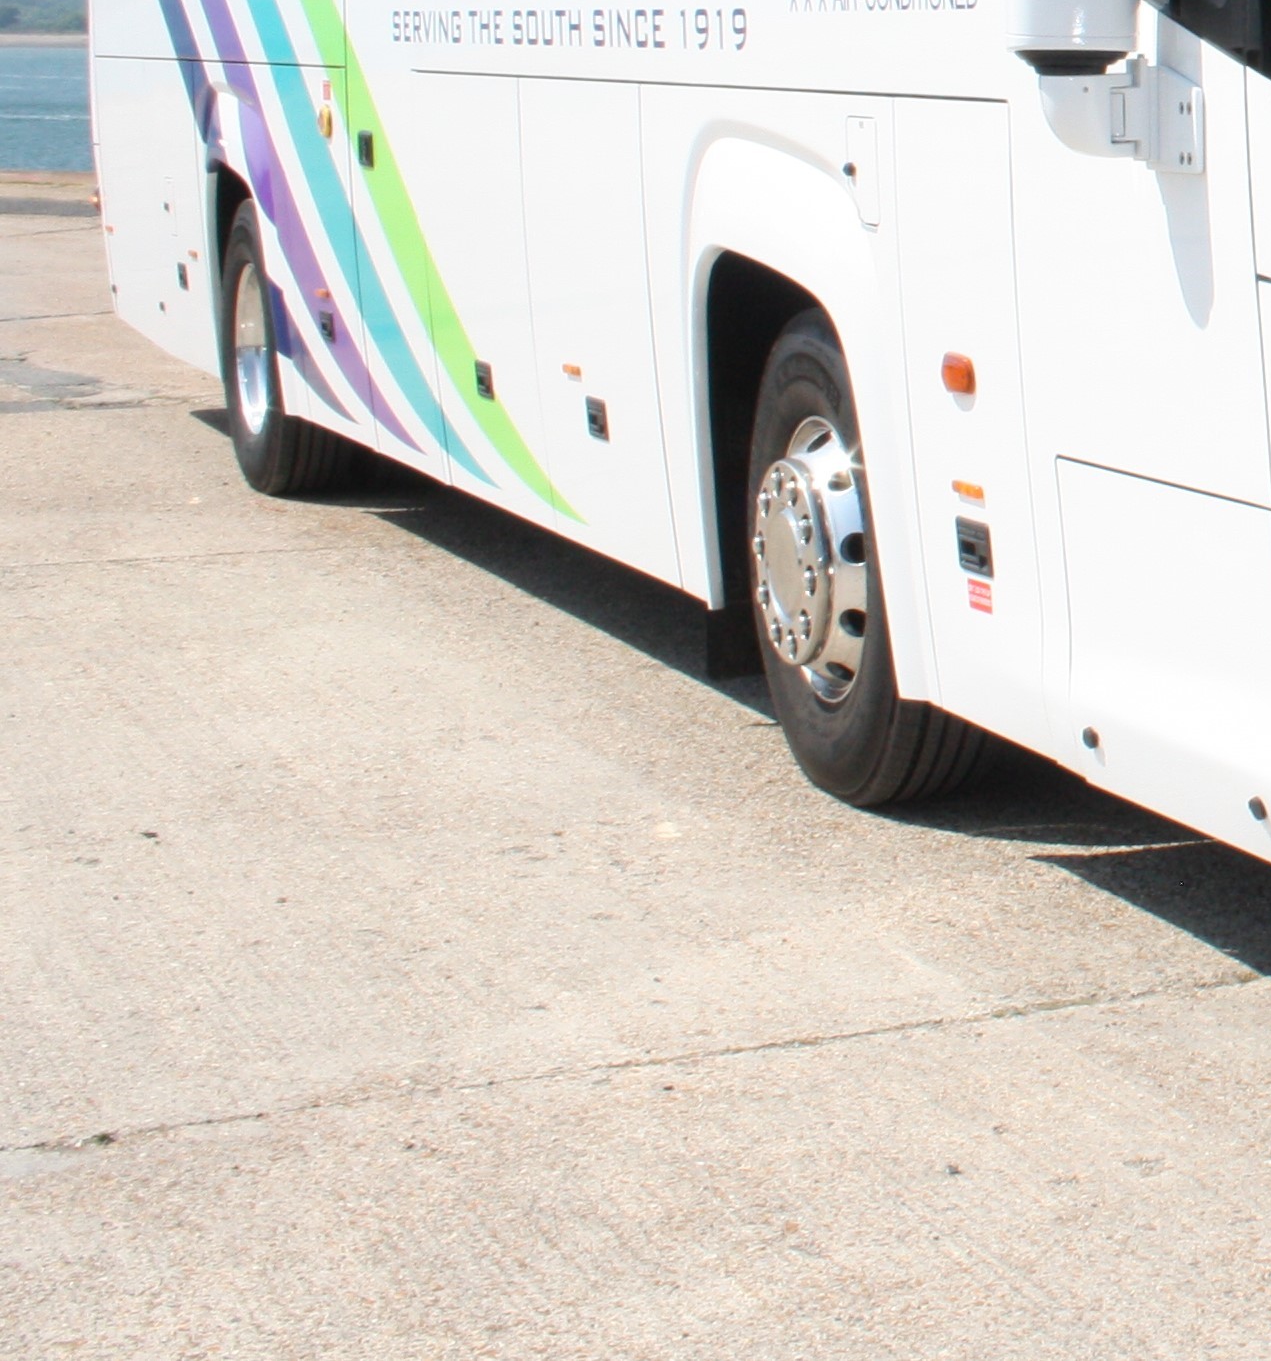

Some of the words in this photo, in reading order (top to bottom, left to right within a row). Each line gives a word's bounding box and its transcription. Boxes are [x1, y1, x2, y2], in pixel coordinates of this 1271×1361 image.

[392, 10, 462, 44] SERVING
[468, 10, 504, 45] THE
[512, 10, 582, 48] SOUTH
[592, 8, 666, 49] SINCE
[679, 8, 748, 51] 1919
